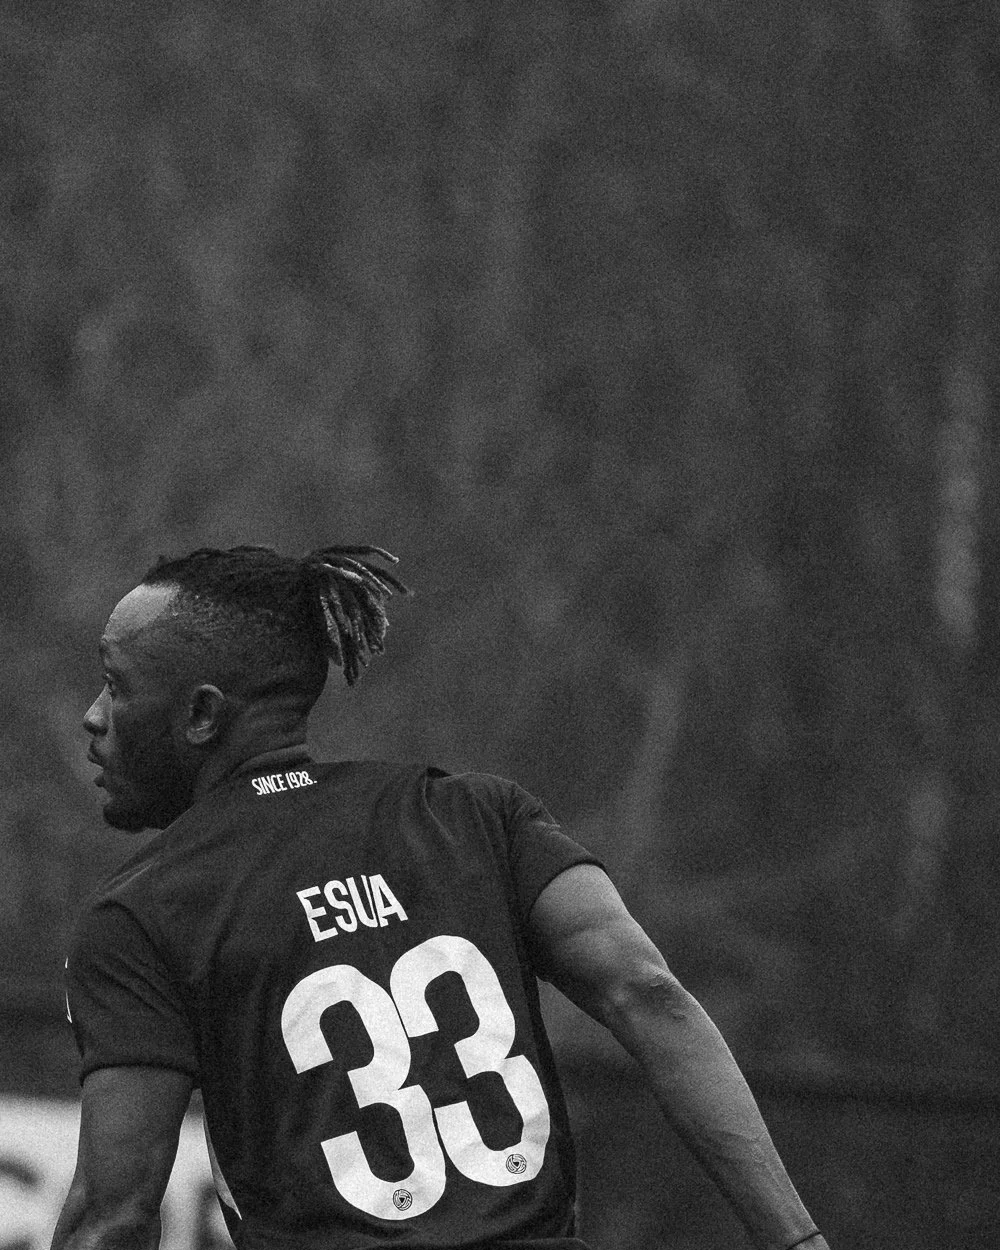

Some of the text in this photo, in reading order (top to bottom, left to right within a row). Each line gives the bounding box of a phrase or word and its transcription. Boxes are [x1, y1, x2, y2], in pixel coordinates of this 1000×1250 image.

[251, 770, 318, 796] SINCE 1928.
[296, 873, 409, 942] ESUA
[281, 935, 551, 1221] 33
